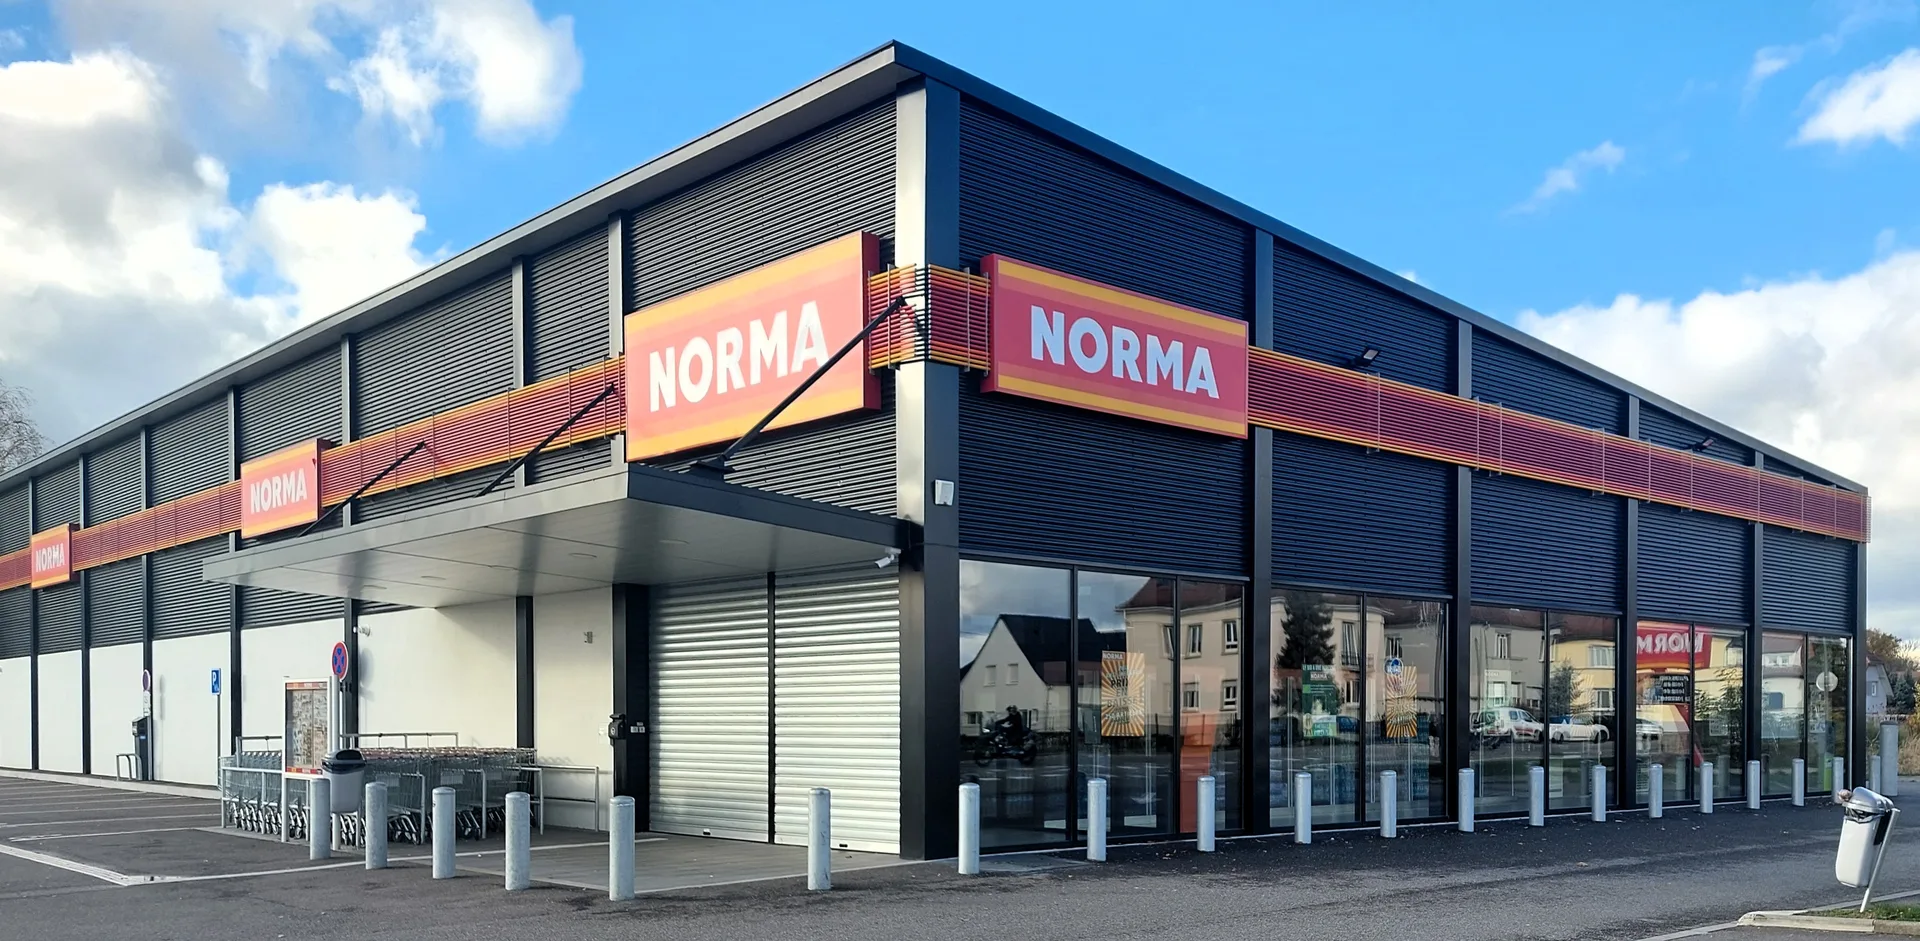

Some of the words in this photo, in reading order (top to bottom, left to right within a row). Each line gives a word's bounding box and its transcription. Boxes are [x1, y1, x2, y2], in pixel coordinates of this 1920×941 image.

[650, 301, 829, 413] NORMA
[1031, 305, 1220, 399] NORMA
[250, 468, 307, 513] NORMA
[35, 543, 65, 572] NORMA
[1102, 652, 1124, 660] NORMA
